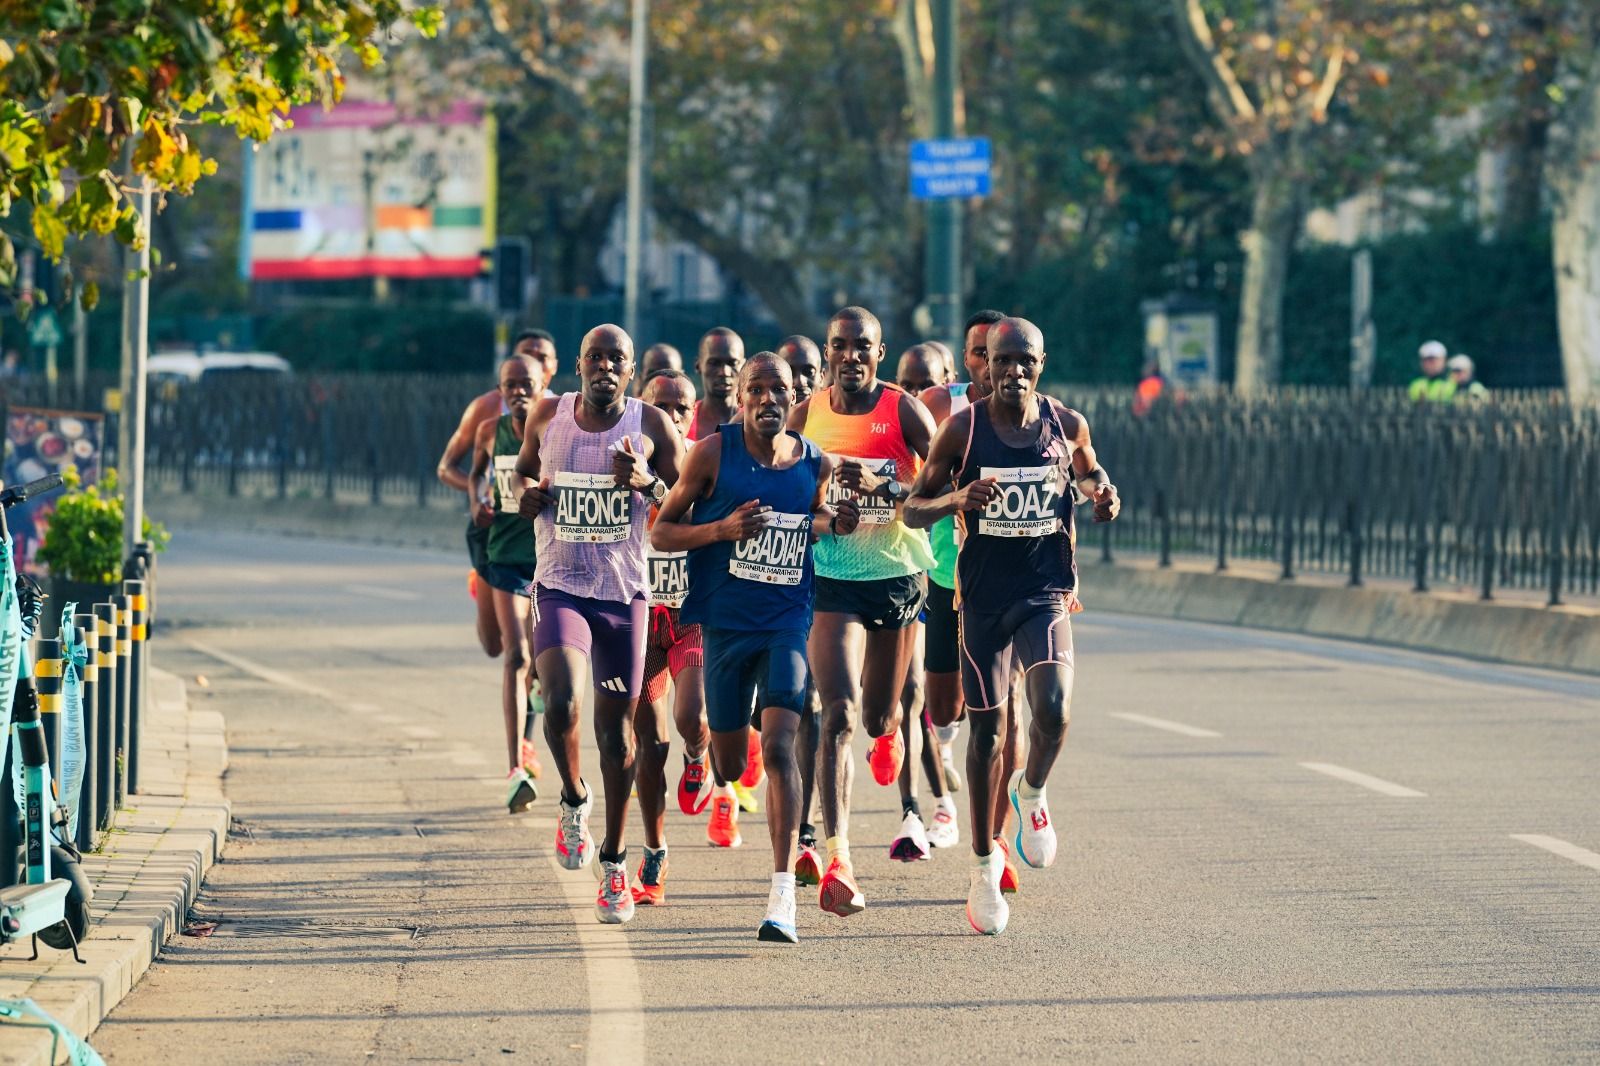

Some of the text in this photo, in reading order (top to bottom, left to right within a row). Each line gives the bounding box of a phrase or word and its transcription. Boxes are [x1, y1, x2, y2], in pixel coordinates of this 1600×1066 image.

[884, 464, 896, 474] 91
[986, 484, 1055, 519] BOAZ
[556, 490, 630, 524] ALFONCE
[802, 521, 810, 530] 93
[1018, 520, 1052, 528] MARATHON
[590, 526, 625, 534] MARATHON
[613, 532, 626, 541] 2025
[736, 528, 807, 567] OBADIAH
[766, 567, 798, 576] MARATHON
